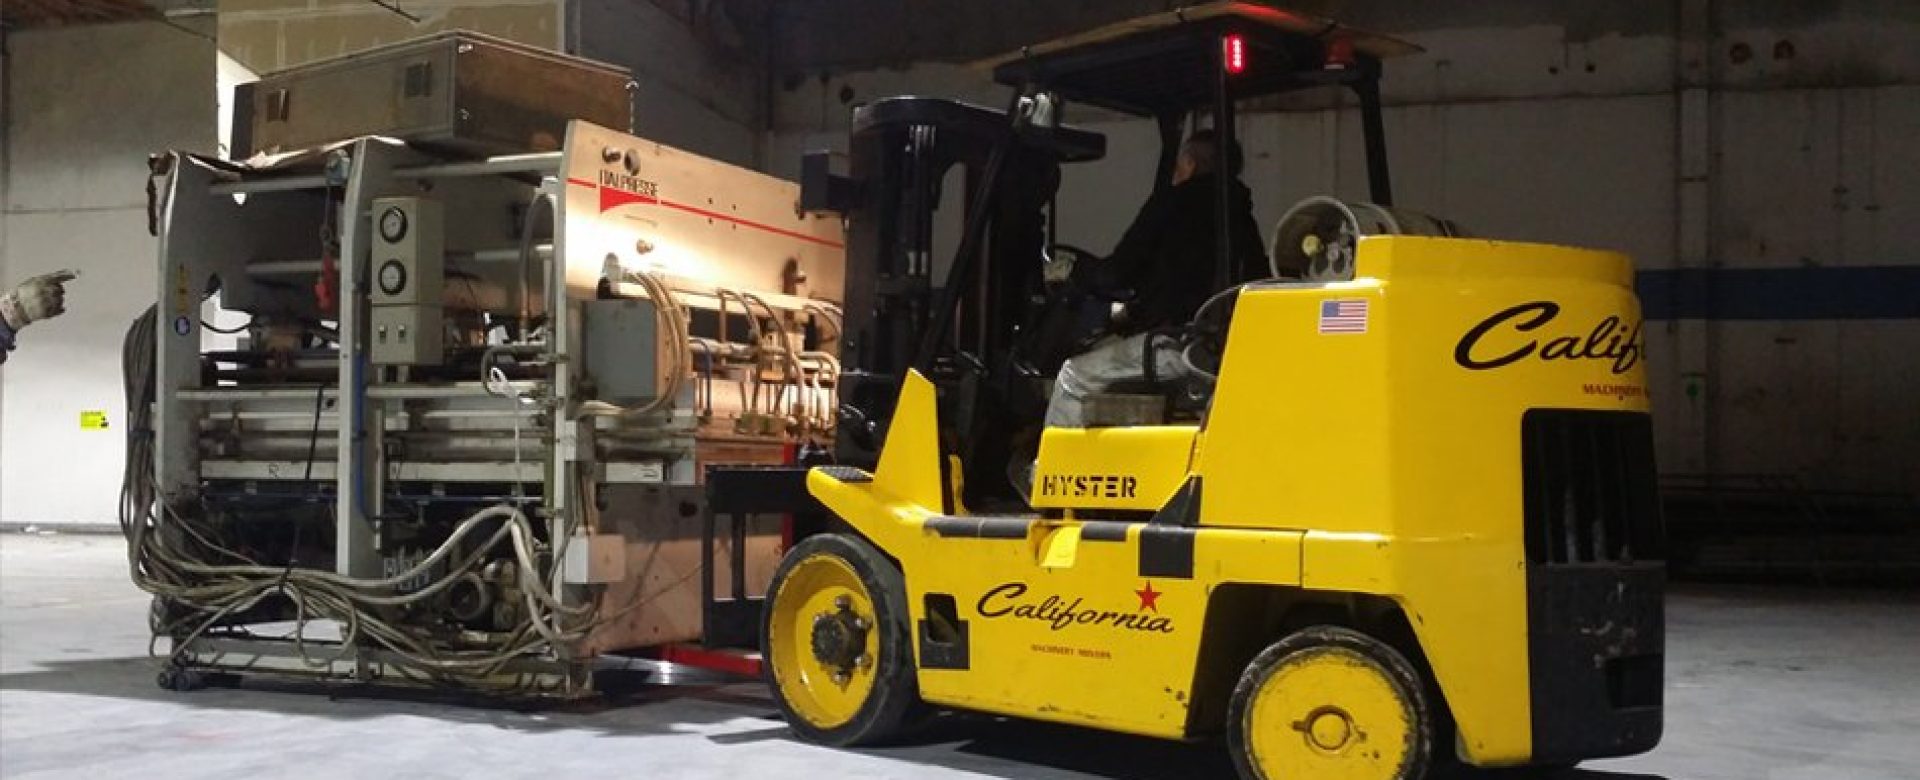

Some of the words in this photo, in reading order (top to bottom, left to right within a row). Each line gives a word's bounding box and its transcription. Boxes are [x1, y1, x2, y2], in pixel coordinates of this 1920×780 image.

[1455, 301, 1643, 373] Calif
[1042, 474, 1137, 498] HYSTER
[977, 581, 1174, 633] California
